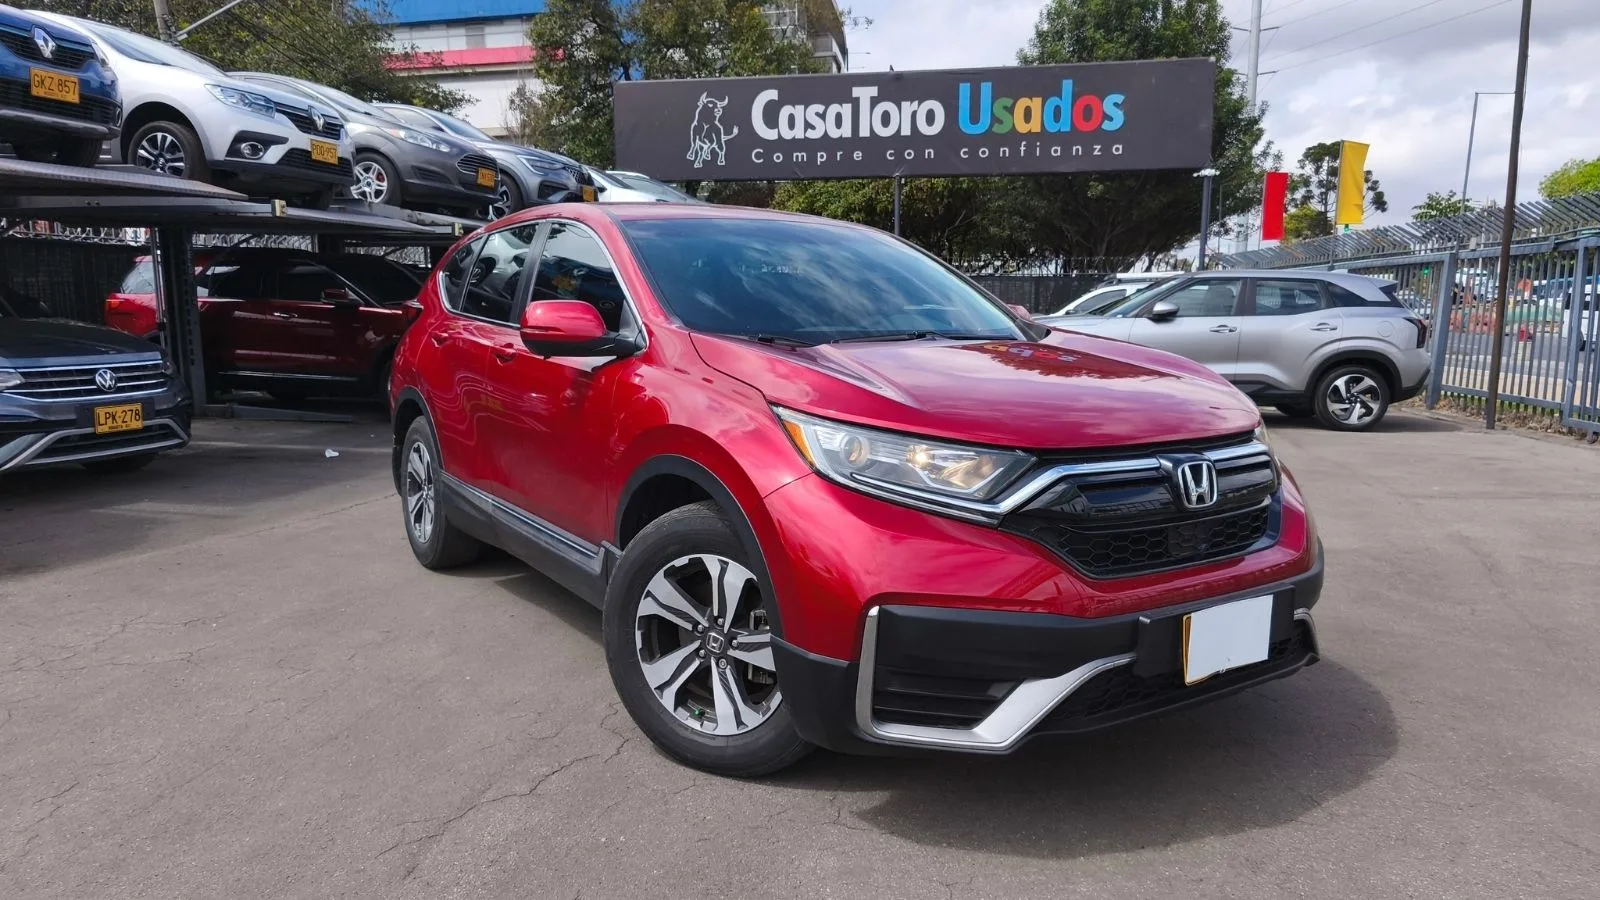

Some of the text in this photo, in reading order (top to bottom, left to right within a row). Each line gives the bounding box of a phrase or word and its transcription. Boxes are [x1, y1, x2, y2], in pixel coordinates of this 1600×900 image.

[33, 73, 77, 96] GKZ 857
[751, 79, 1126, 141] CasaToro Usados
[751, 141, 1123, 165] Compre con confianza
